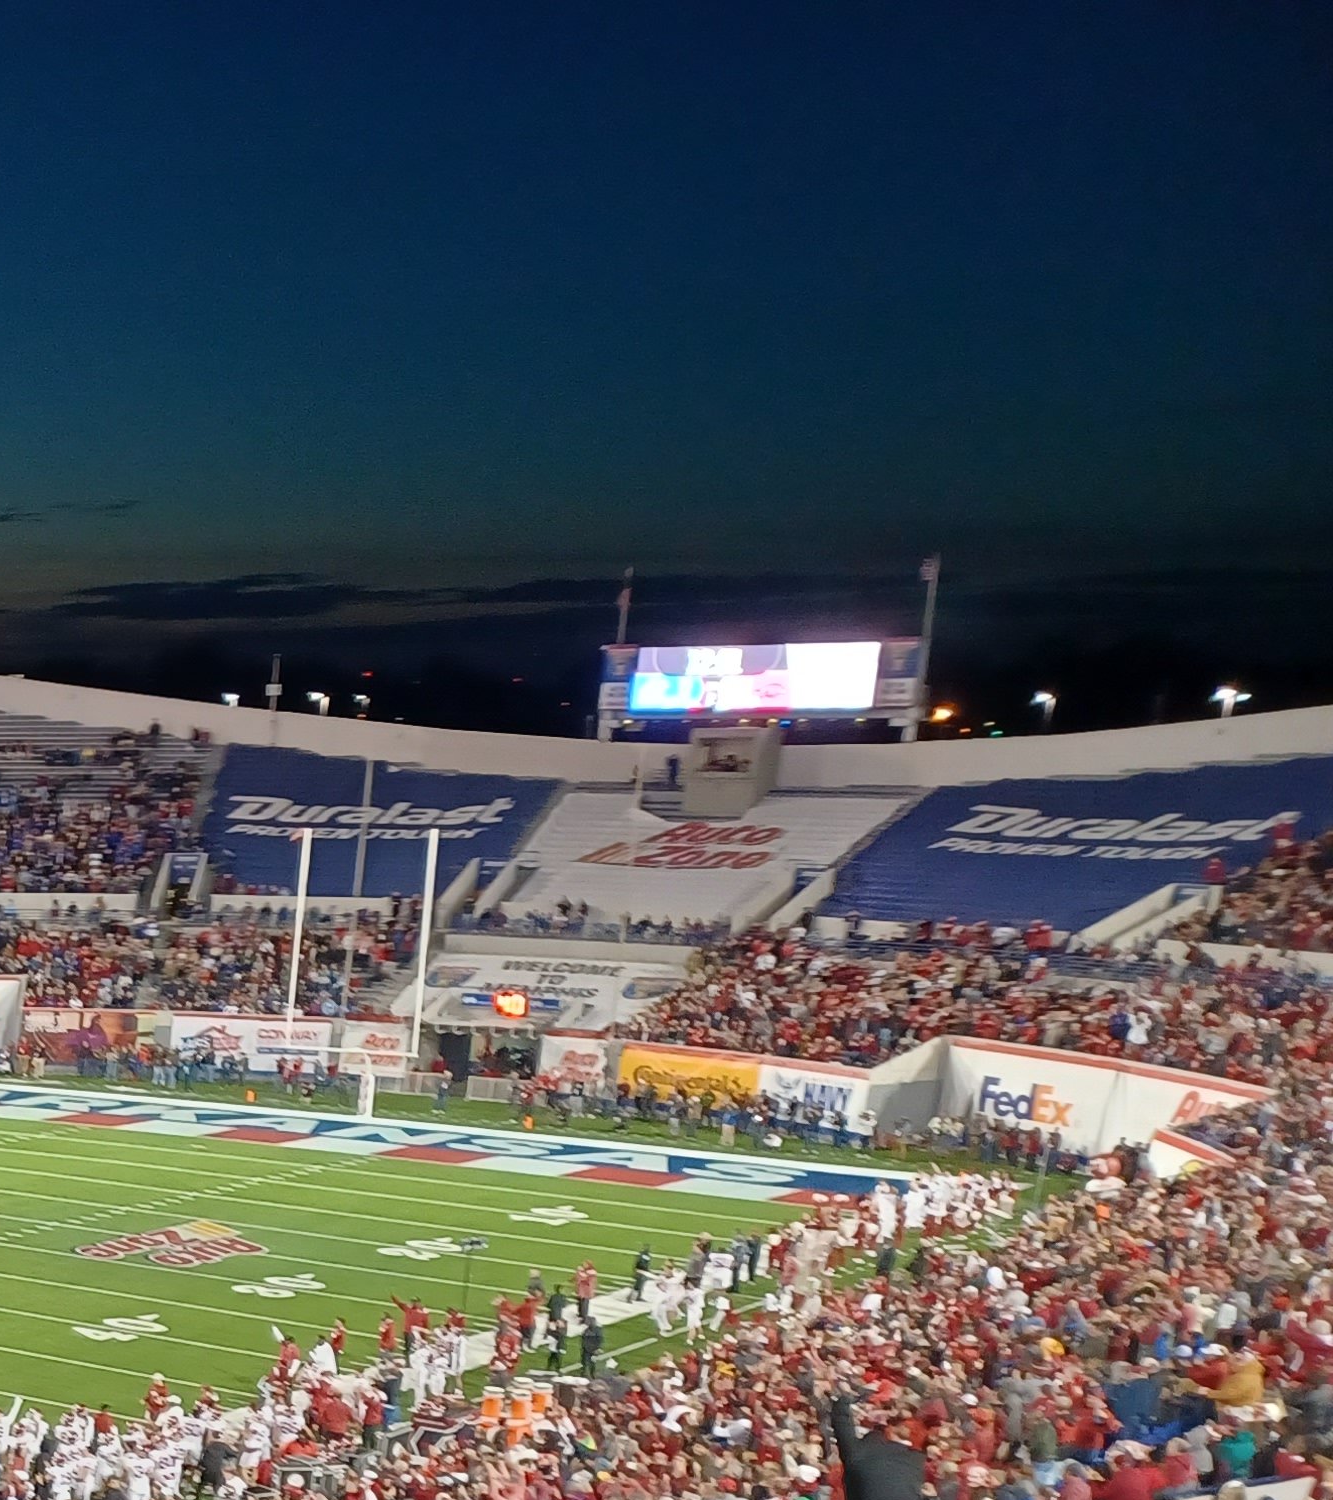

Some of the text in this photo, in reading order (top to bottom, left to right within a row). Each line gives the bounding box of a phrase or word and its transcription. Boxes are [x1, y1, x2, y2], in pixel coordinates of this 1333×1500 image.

[226, 795, 517, 826] Duralast
[226, 823, 359, 840] PROEN
[640, 821, 785, 845] Auto
[945, 804, 1301, 842] Duralast
[634, 845, 774, 869] Zone
[927, 836, 1229, 860] PROVEN TOUGH
[502, 960, 627, 977] WELCOME
[535, 974, 568, 985] TO
[979, 1075, 1073, 1127] FedEx
[72, 1228, 196, 1261] Zone
[145, 1237, 270, 1269] Auto
